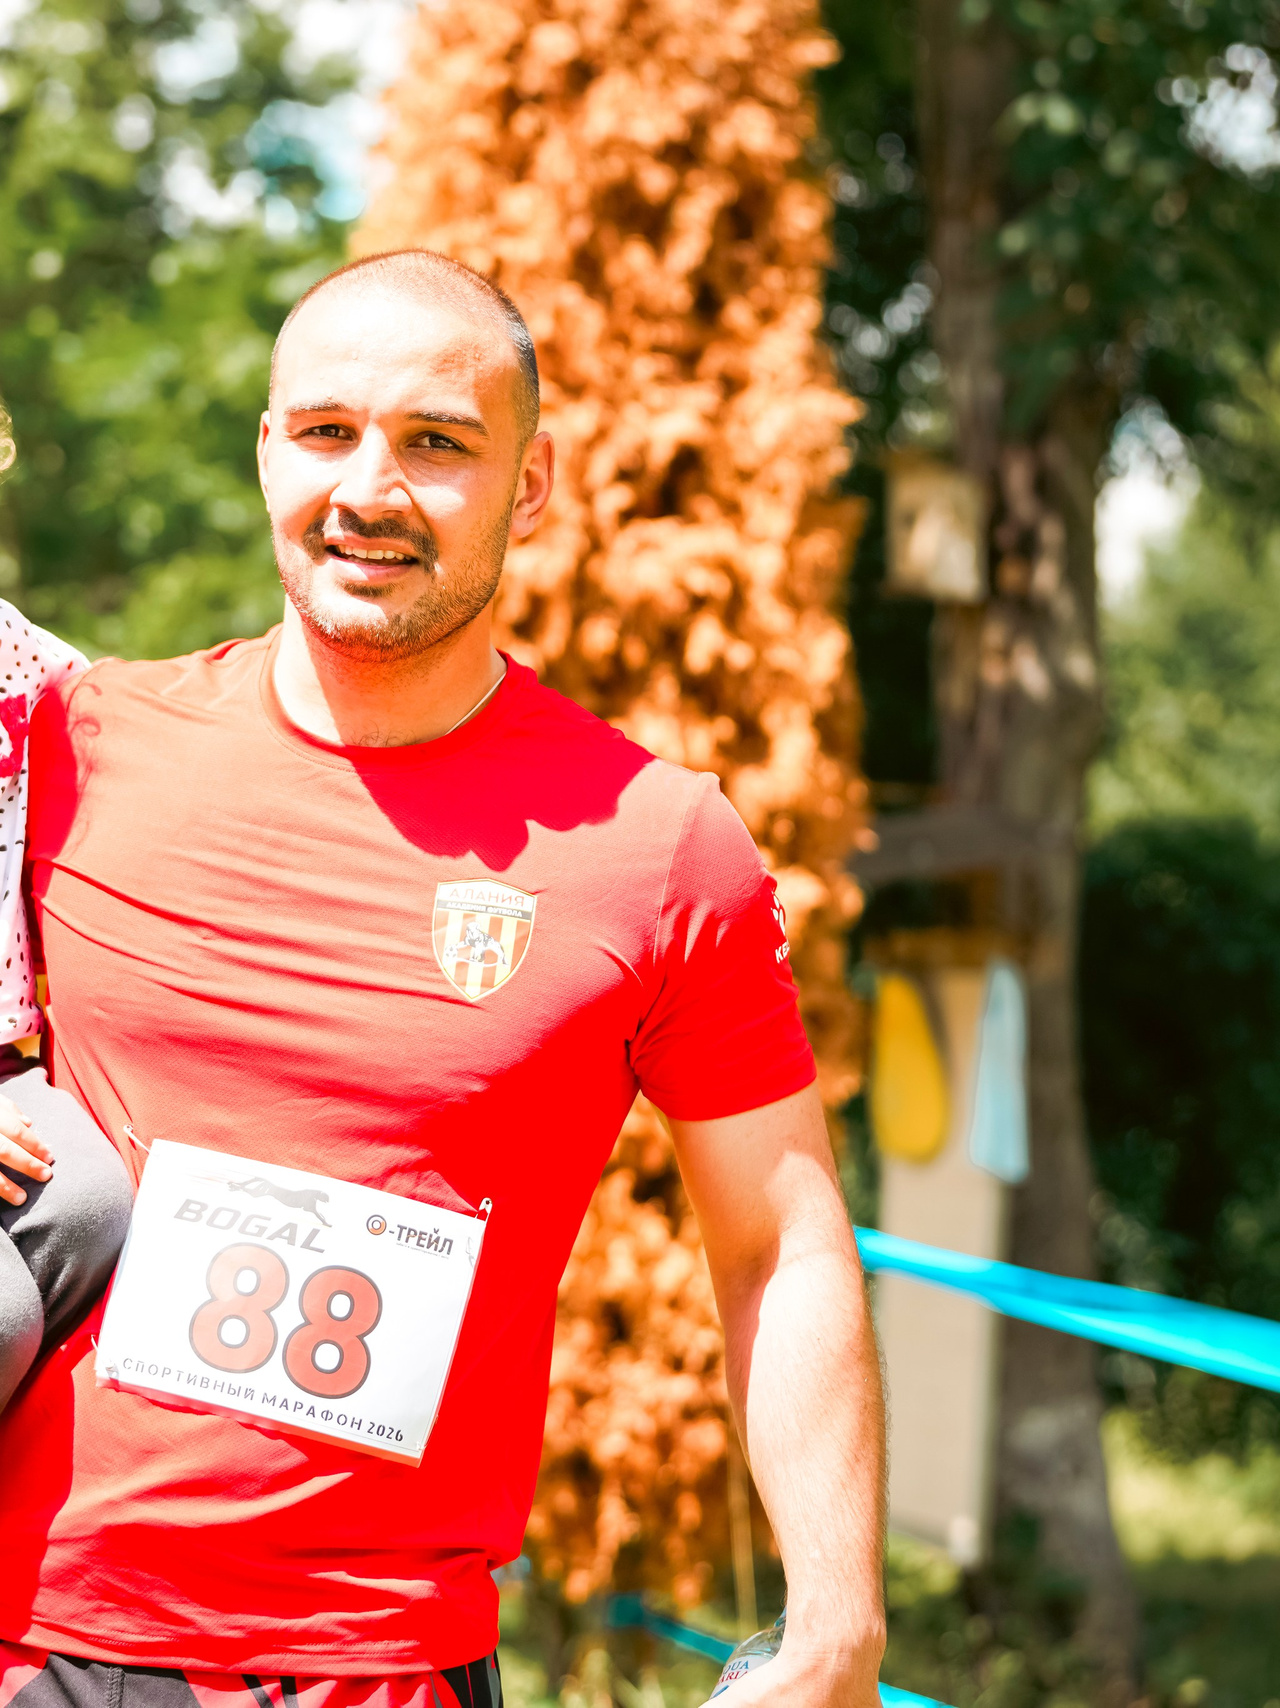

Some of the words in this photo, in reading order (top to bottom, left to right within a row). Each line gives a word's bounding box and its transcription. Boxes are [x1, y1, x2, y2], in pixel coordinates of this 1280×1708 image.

[446, 901, 486, 911] АКАДЕМИЯ
[487, 906, 522, 917] ФУТБОЛА
[450, 888, 525, 906] АЛАНИЯ
[173, 1199, 325, 1253] BOGAL
[189, 1242, 383, 1399] 88
[123, 1358, 255, 1400] СПОРТИВНЫЙ
[262, 1393, 363, 1430] МАРАФОН
[367, 1421, 403, 1442] 2026
